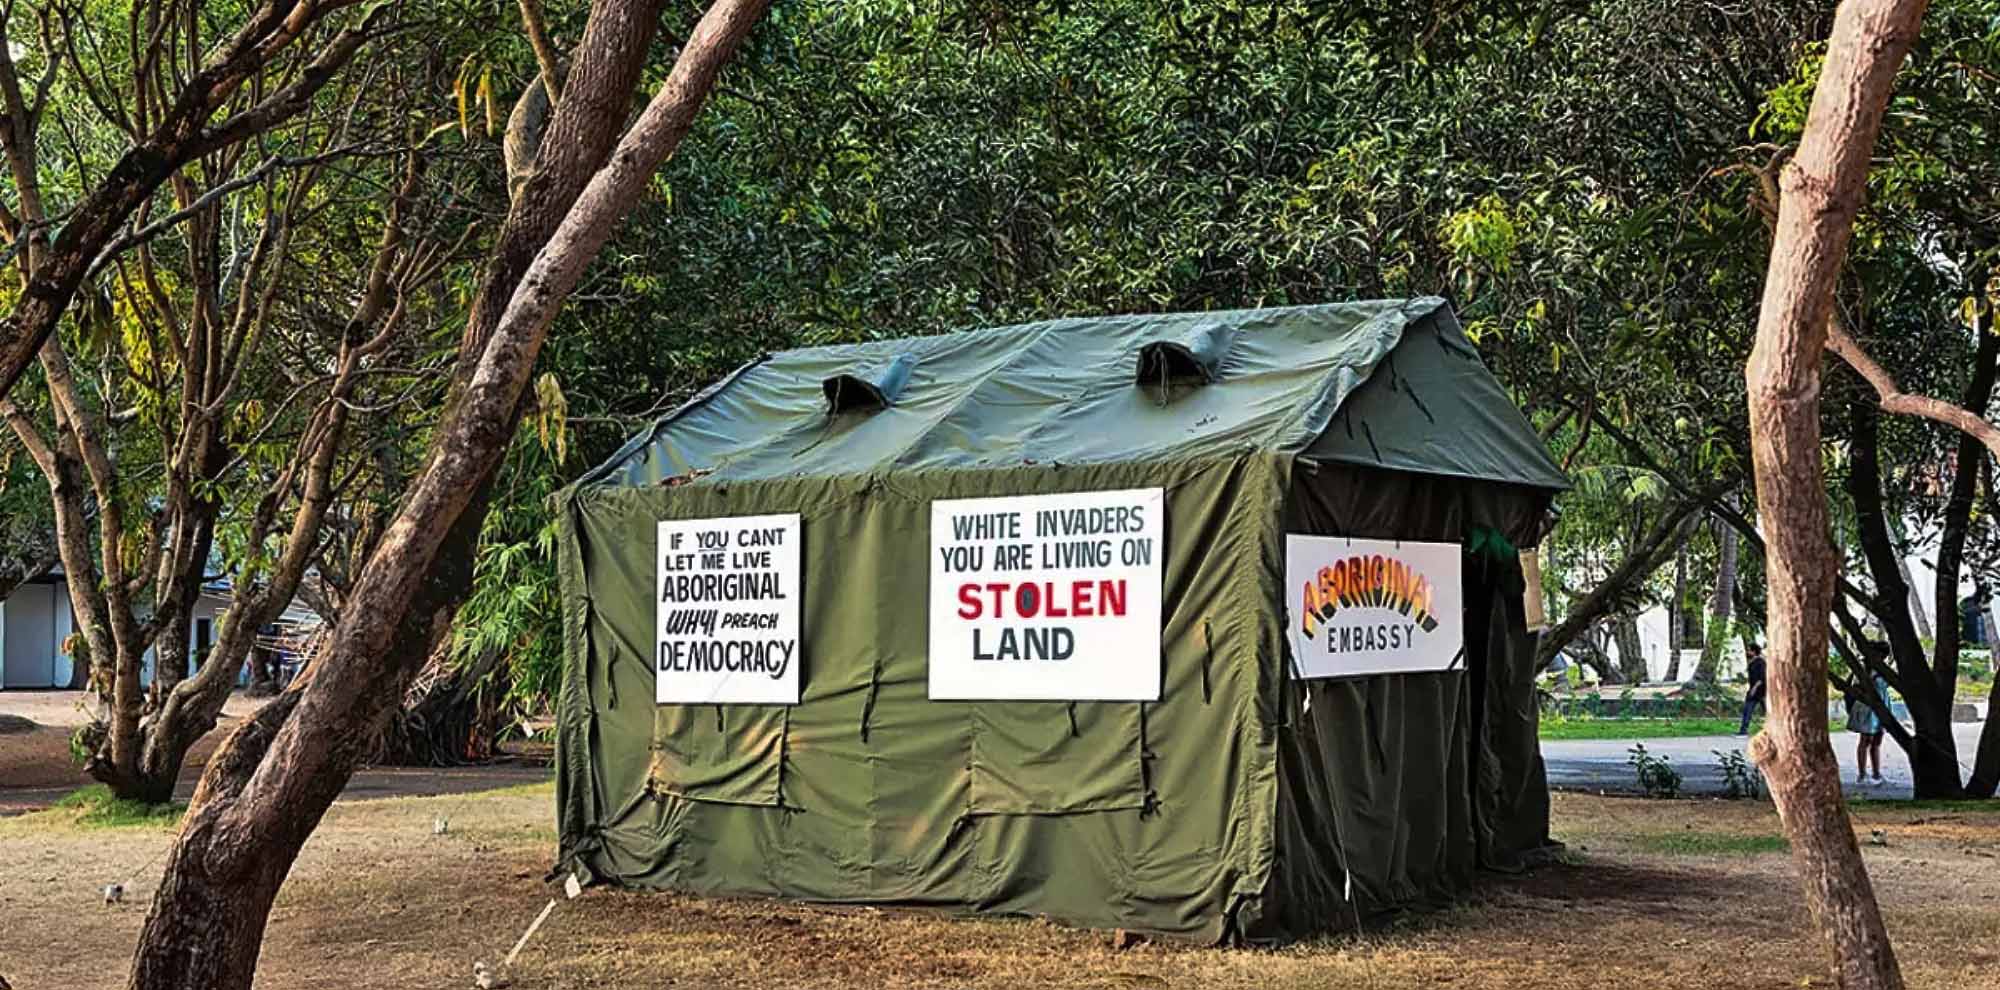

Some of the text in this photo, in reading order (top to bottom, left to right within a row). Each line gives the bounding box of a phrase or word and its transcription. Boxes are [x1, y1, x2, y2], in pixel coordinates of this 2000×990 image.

[670, 527, 786, 550] IF YOU CANT
[952, 505, 1144, 540] WHITE INVADERS
[665, 551, 771, 571] LET ME LIVE
[940, 538, 1153, 573] YOU ARE LIVING ON
[662, 572, 786, 602] ABORIGINAL
[957, 579, 1127, 620] STOLEN
[1302, 554, 1439, 641] ABORIGINAL
[665, 609, 779, 637] WHY! PREACH
[1327, 623, 1415, 653] EMBASSY
[660, 639, 795, 680] DEMOCRACY
[972, 627, 1075, 661] LAND
